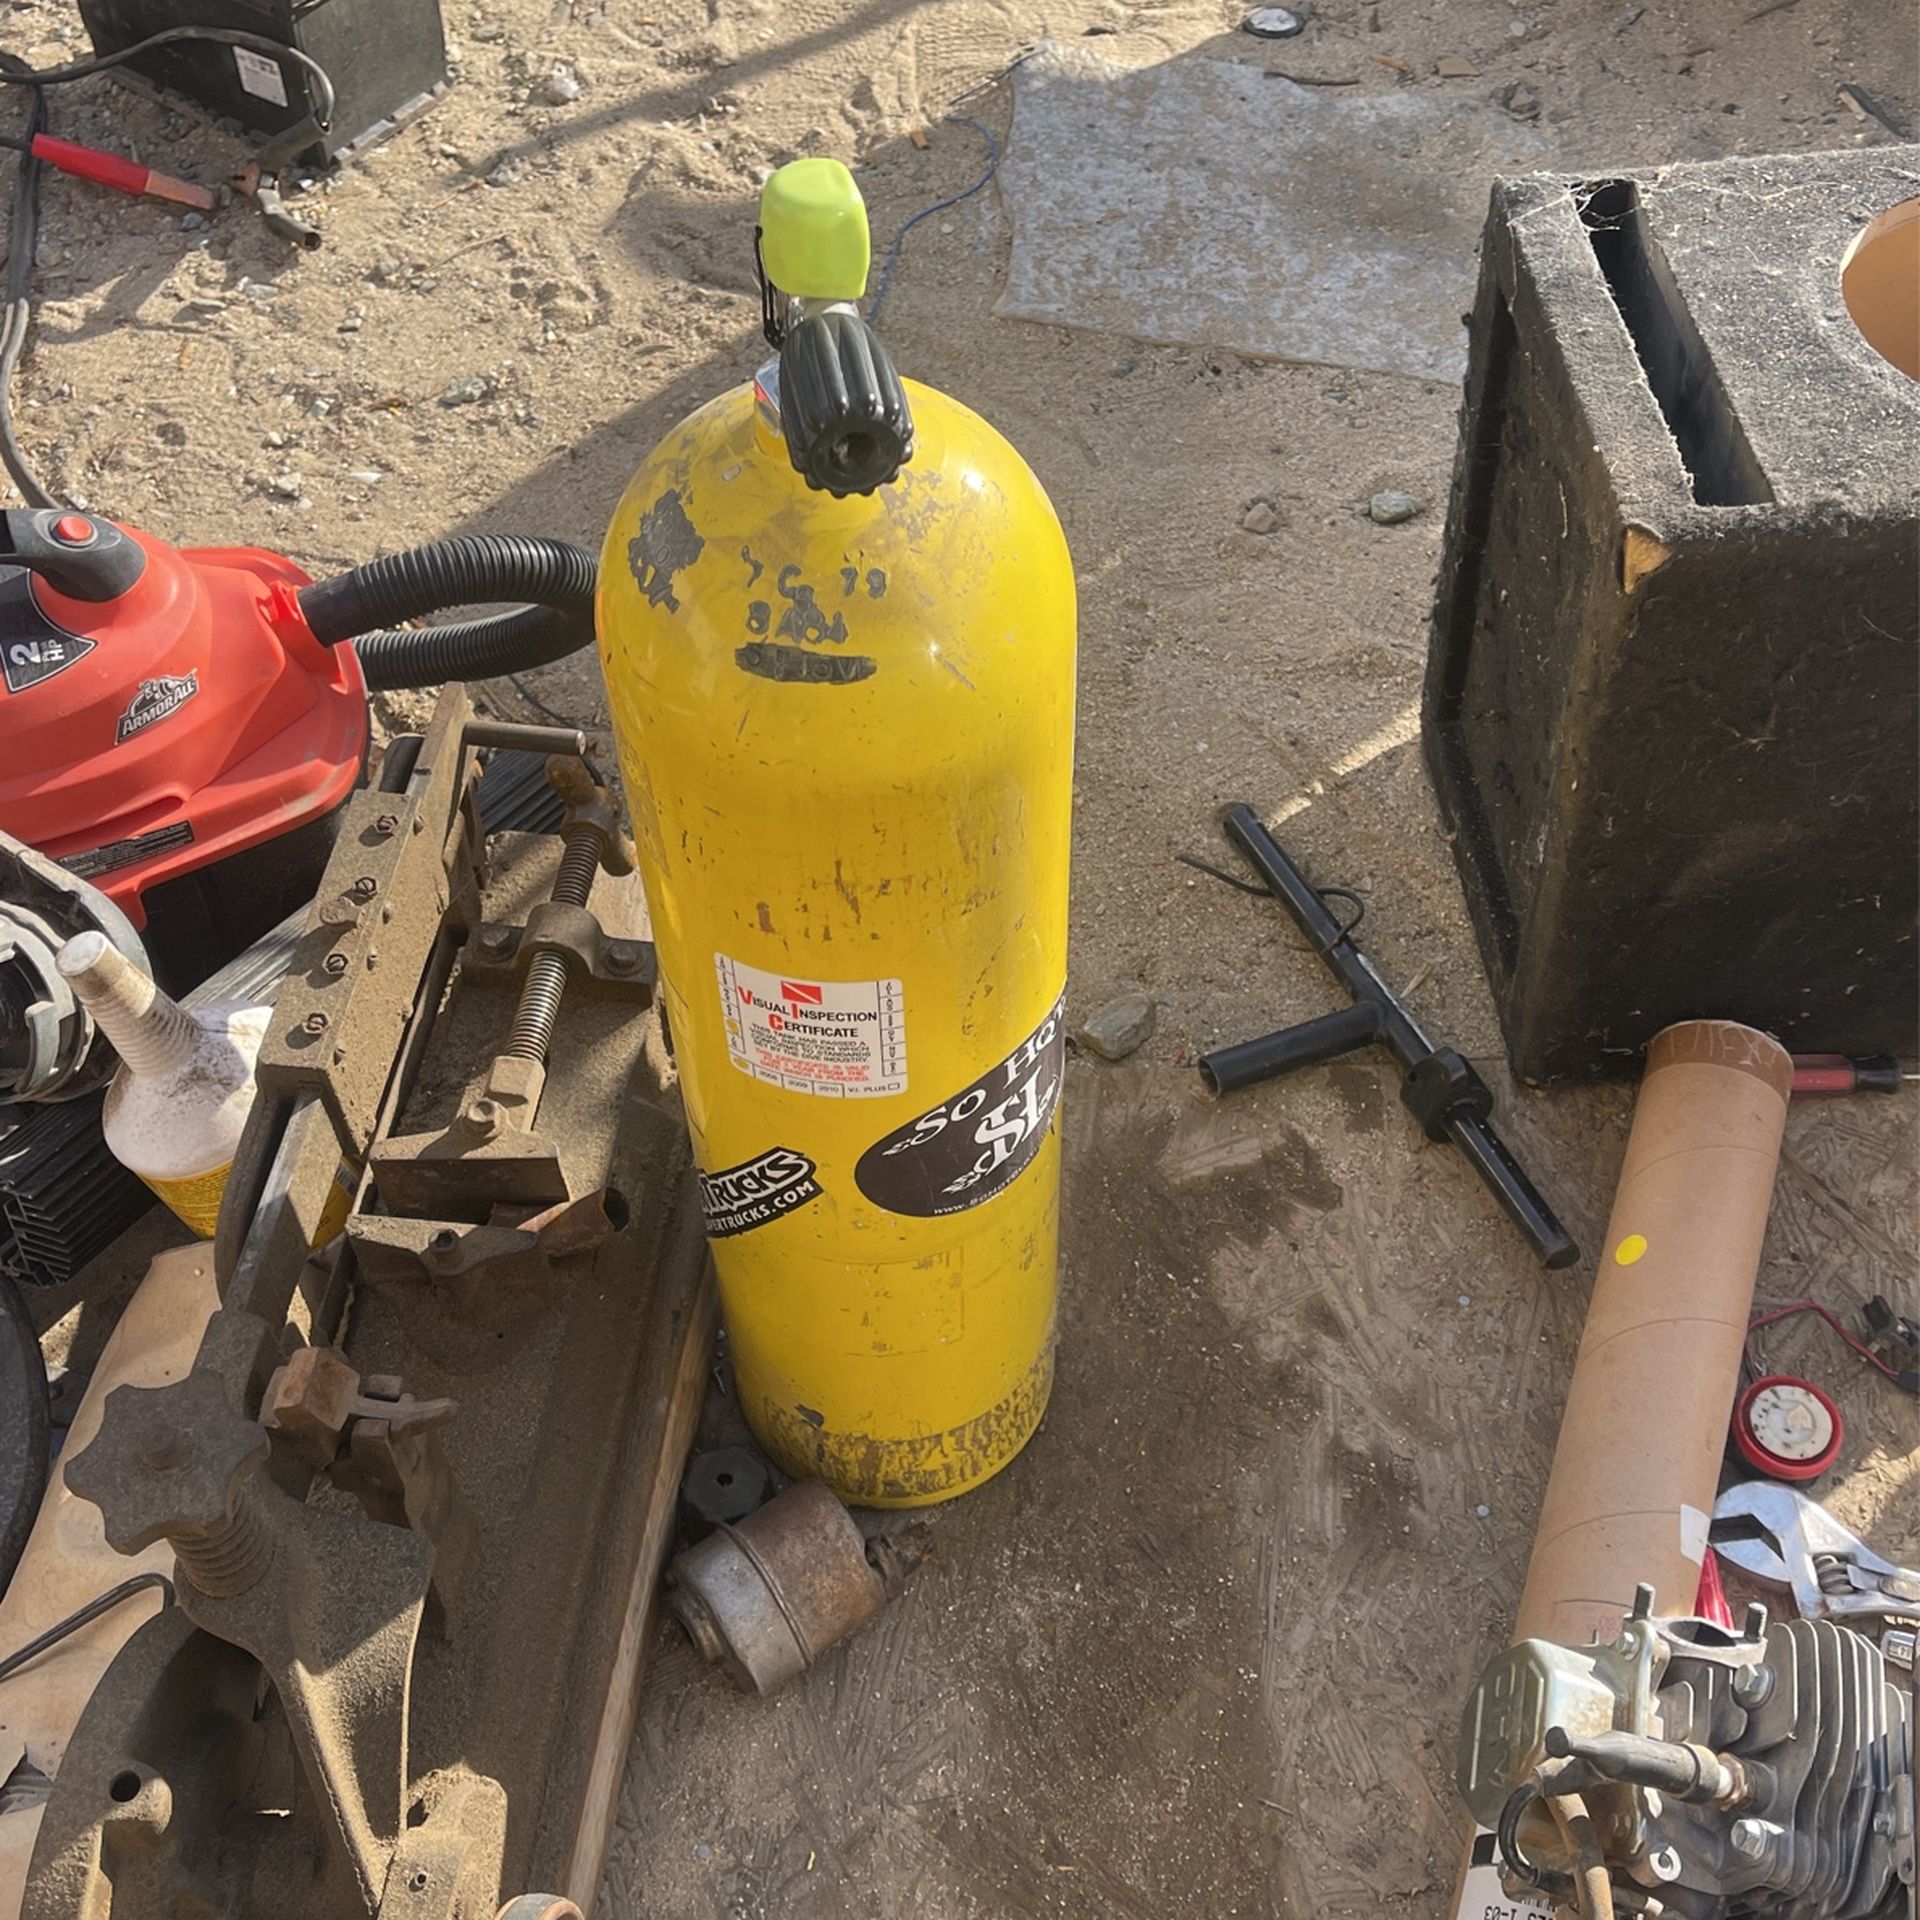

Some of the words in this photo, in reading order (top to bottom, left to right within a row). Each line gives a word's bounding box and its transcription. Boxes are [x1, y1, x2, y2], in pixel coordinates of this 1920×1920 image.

[10, 641, 41, 666] 2
[51, 639, 65, 662] HP
[738, 986, 790, 1015] VISUAL
[791, 1003, 877, 1021] INSPECTION
[769, 1014, 858, 1037] CERTIFICATE
[863, 1085, 887, 1093] PLUS
